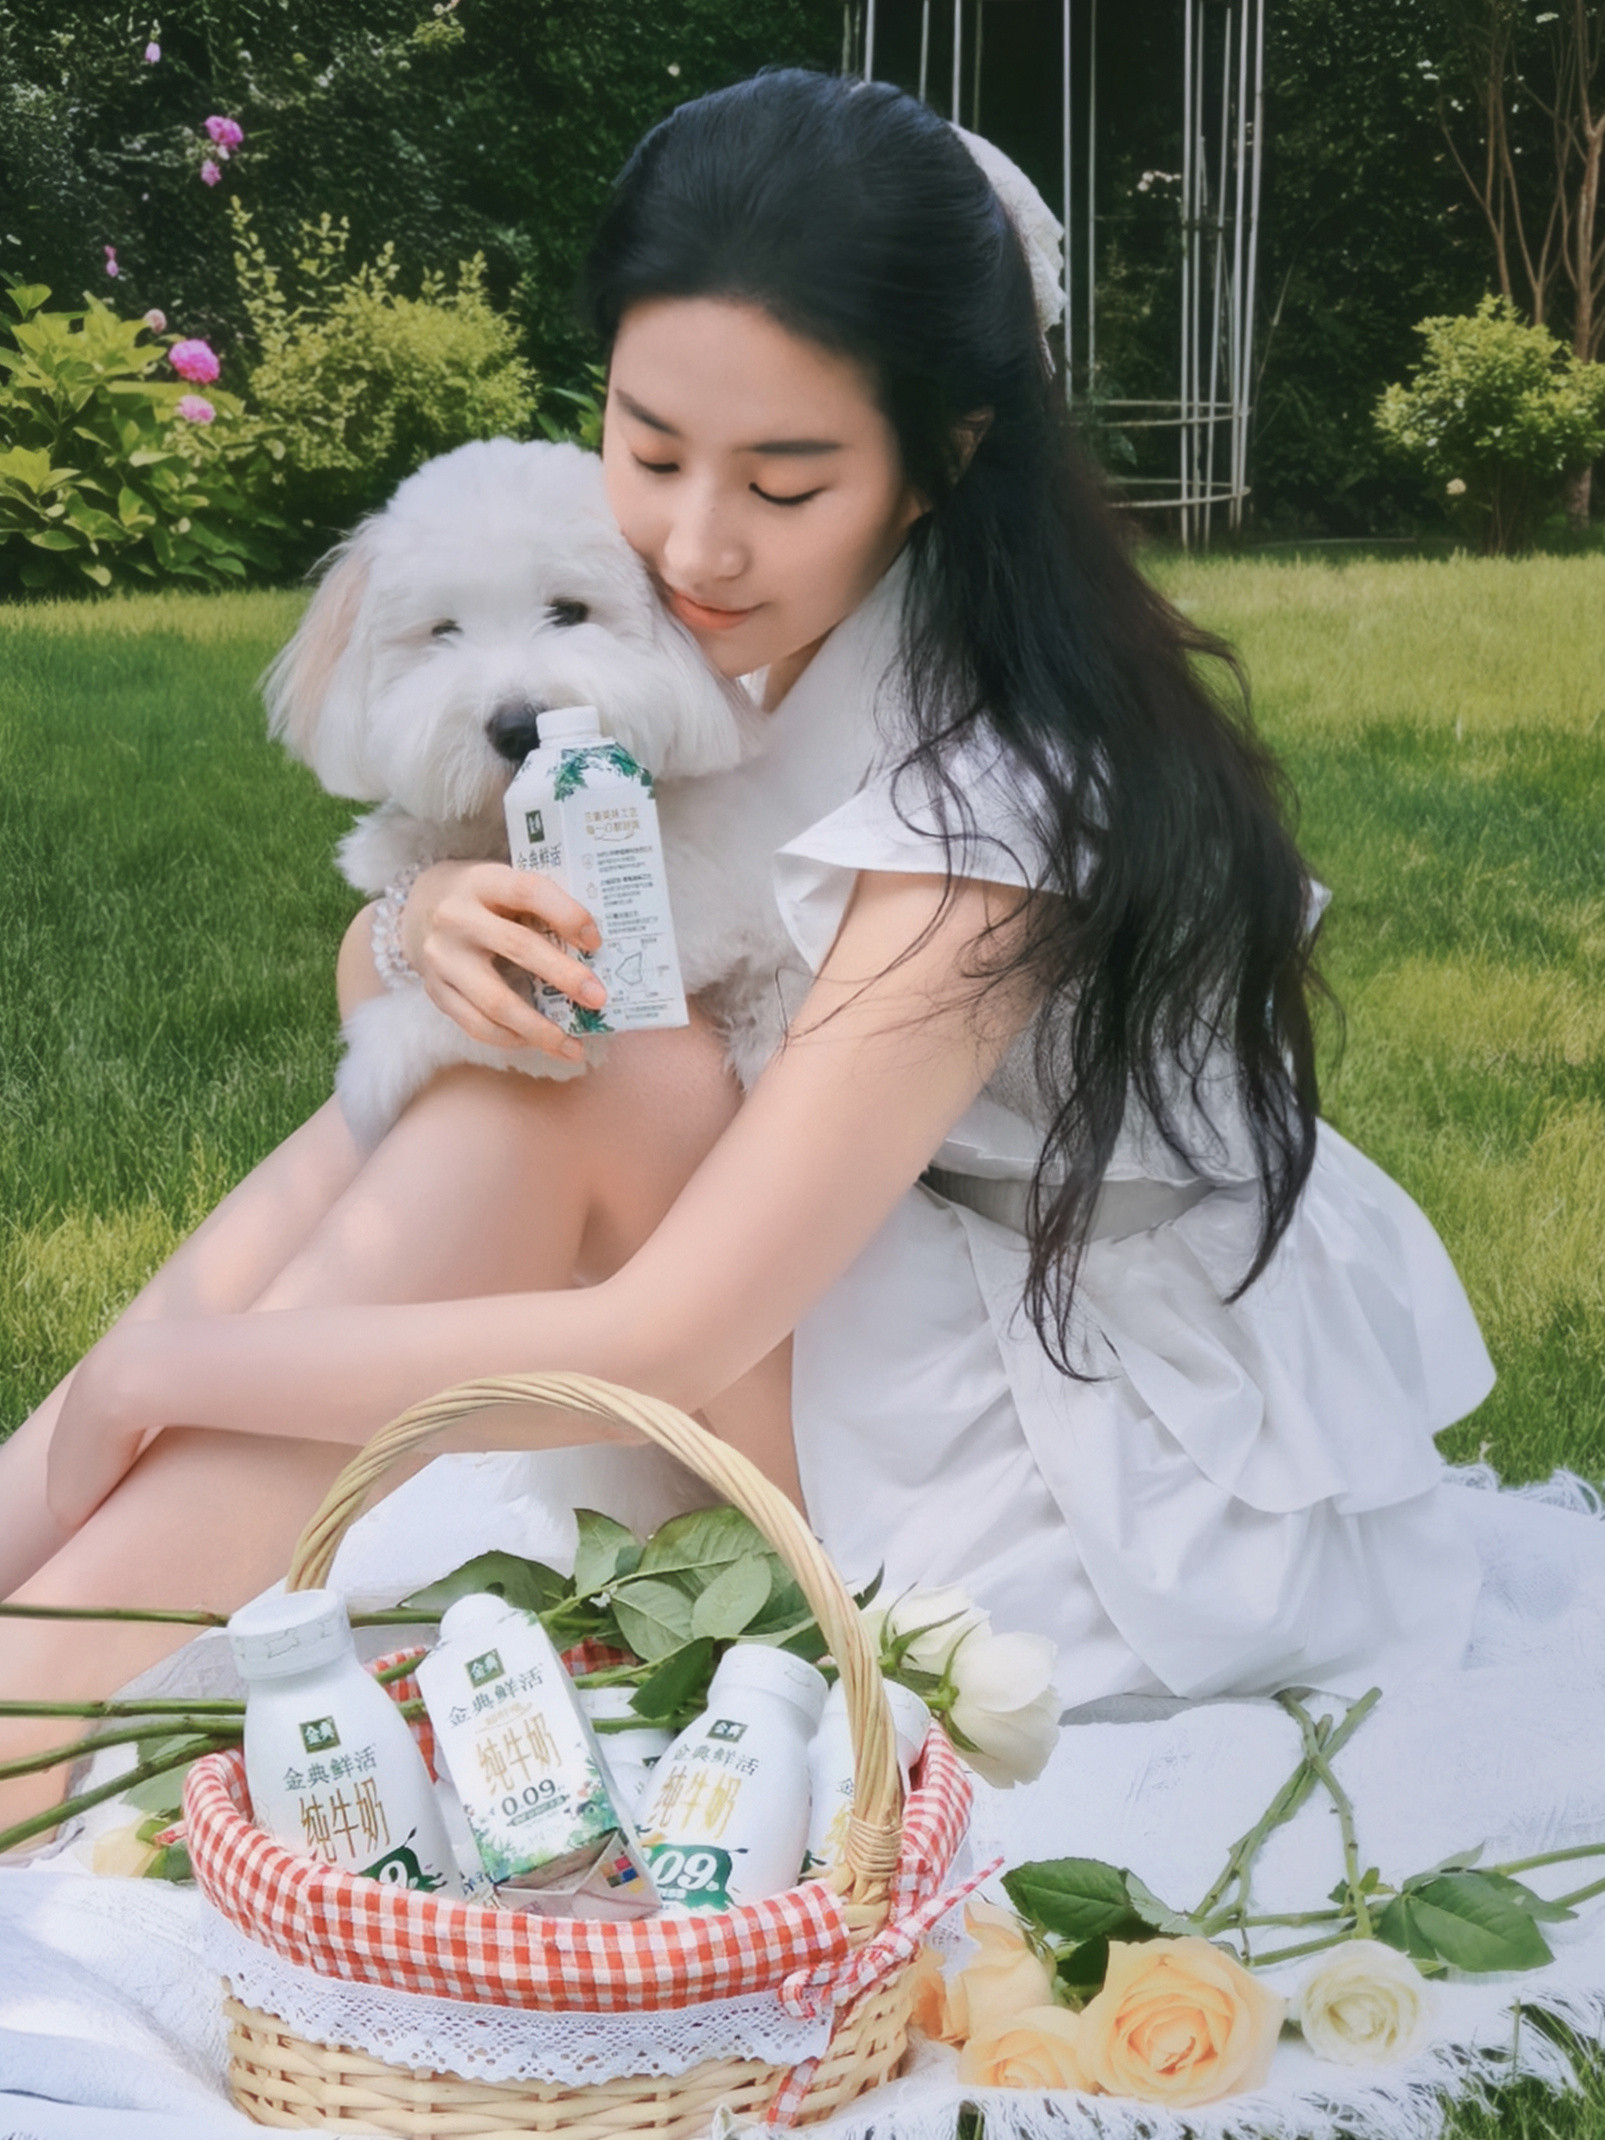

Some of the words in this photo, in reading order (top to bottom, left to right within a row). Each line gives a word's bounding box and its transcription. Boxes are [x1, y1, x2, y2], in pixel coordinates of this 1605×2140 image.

[448, 1665, 543, 1729] 金典鲜活
[283, 1746, 377, 1791] 金典鲜活
[476, 1712, 562, 1796] 纯牛奶
[674, 1744, 759, 1776] 金典鲜活
[299, 1776, 390, 1863] 纯牛奶
[647, 1765, 742, 1839] 纯牛奶
[641, 1847, 717, 1890] 09
